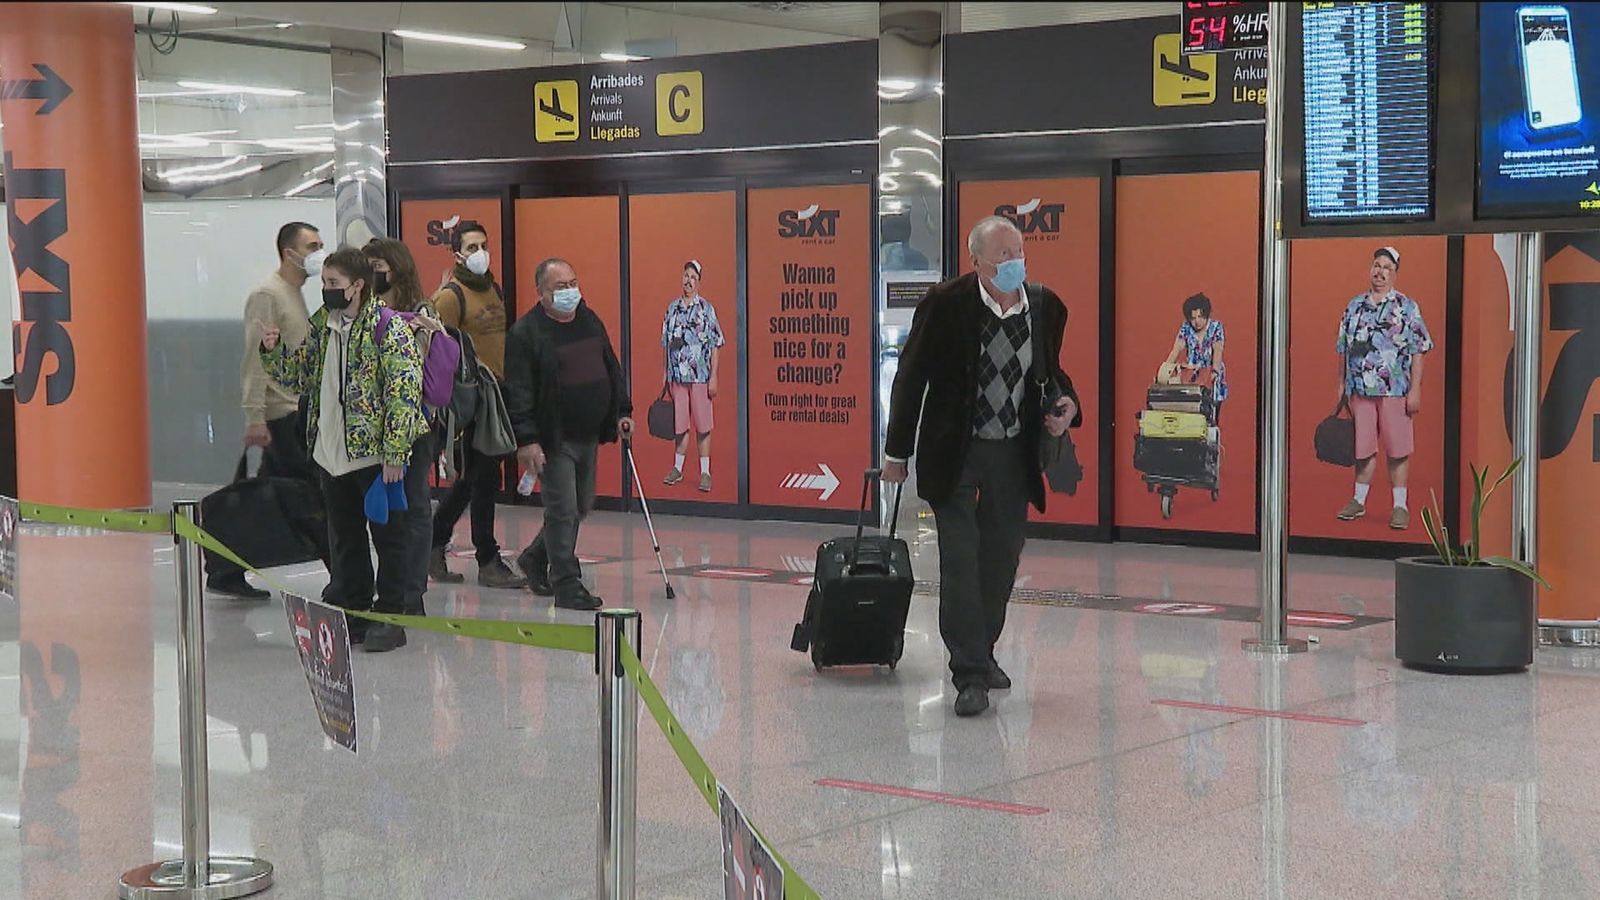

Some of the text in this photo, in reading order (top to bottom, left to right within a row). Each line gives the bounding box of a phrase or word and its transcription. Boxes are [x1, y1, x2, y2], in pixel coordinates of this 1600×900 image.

[1188, 17, 1227, 47] 54
[590, 73, 644, 89] Arribades
[590, 92, 623, 105] Arrivals
[668, 84, 691, 123] C
[590, 109, 623, 123] Ankunft
[590, 125, 640, 141] Llegadas
[783, 263, 836, 285] Wanna
[781, 288, 838, 311] pick up
[769, 313, 850, 336] something
[773, 338, 846, 359] nice for a
[777, 362, 843, 386] change?
[765, 393, 857, 409] (Turn right for great
[771, 408, 849, 425] car rental deals)
